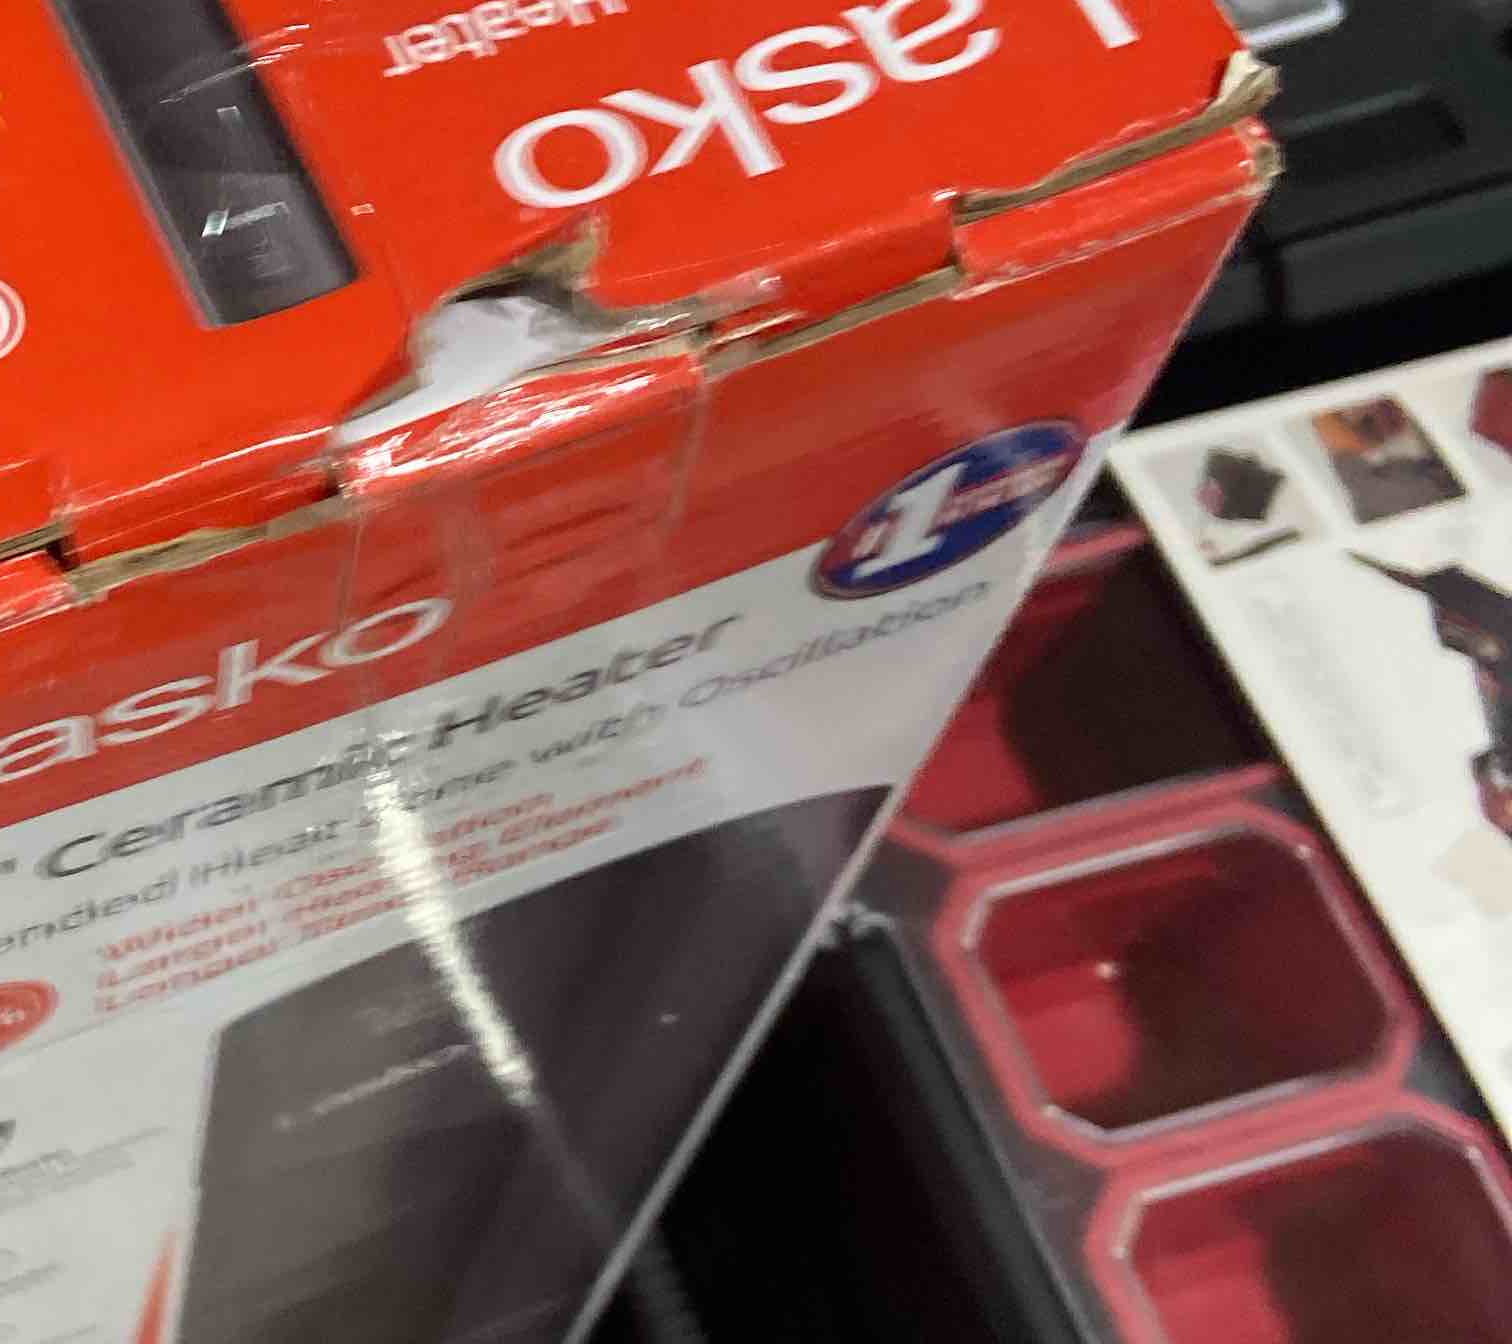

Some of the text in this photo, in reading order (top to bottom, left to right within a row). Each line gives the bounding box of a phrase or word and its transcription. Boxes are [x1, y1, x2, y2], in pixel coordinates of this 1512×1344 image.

[189, 819, 341, 887] Heat
[677, 578, 993, 710] Oscillation
[426, 612, 746, 752] Heater
